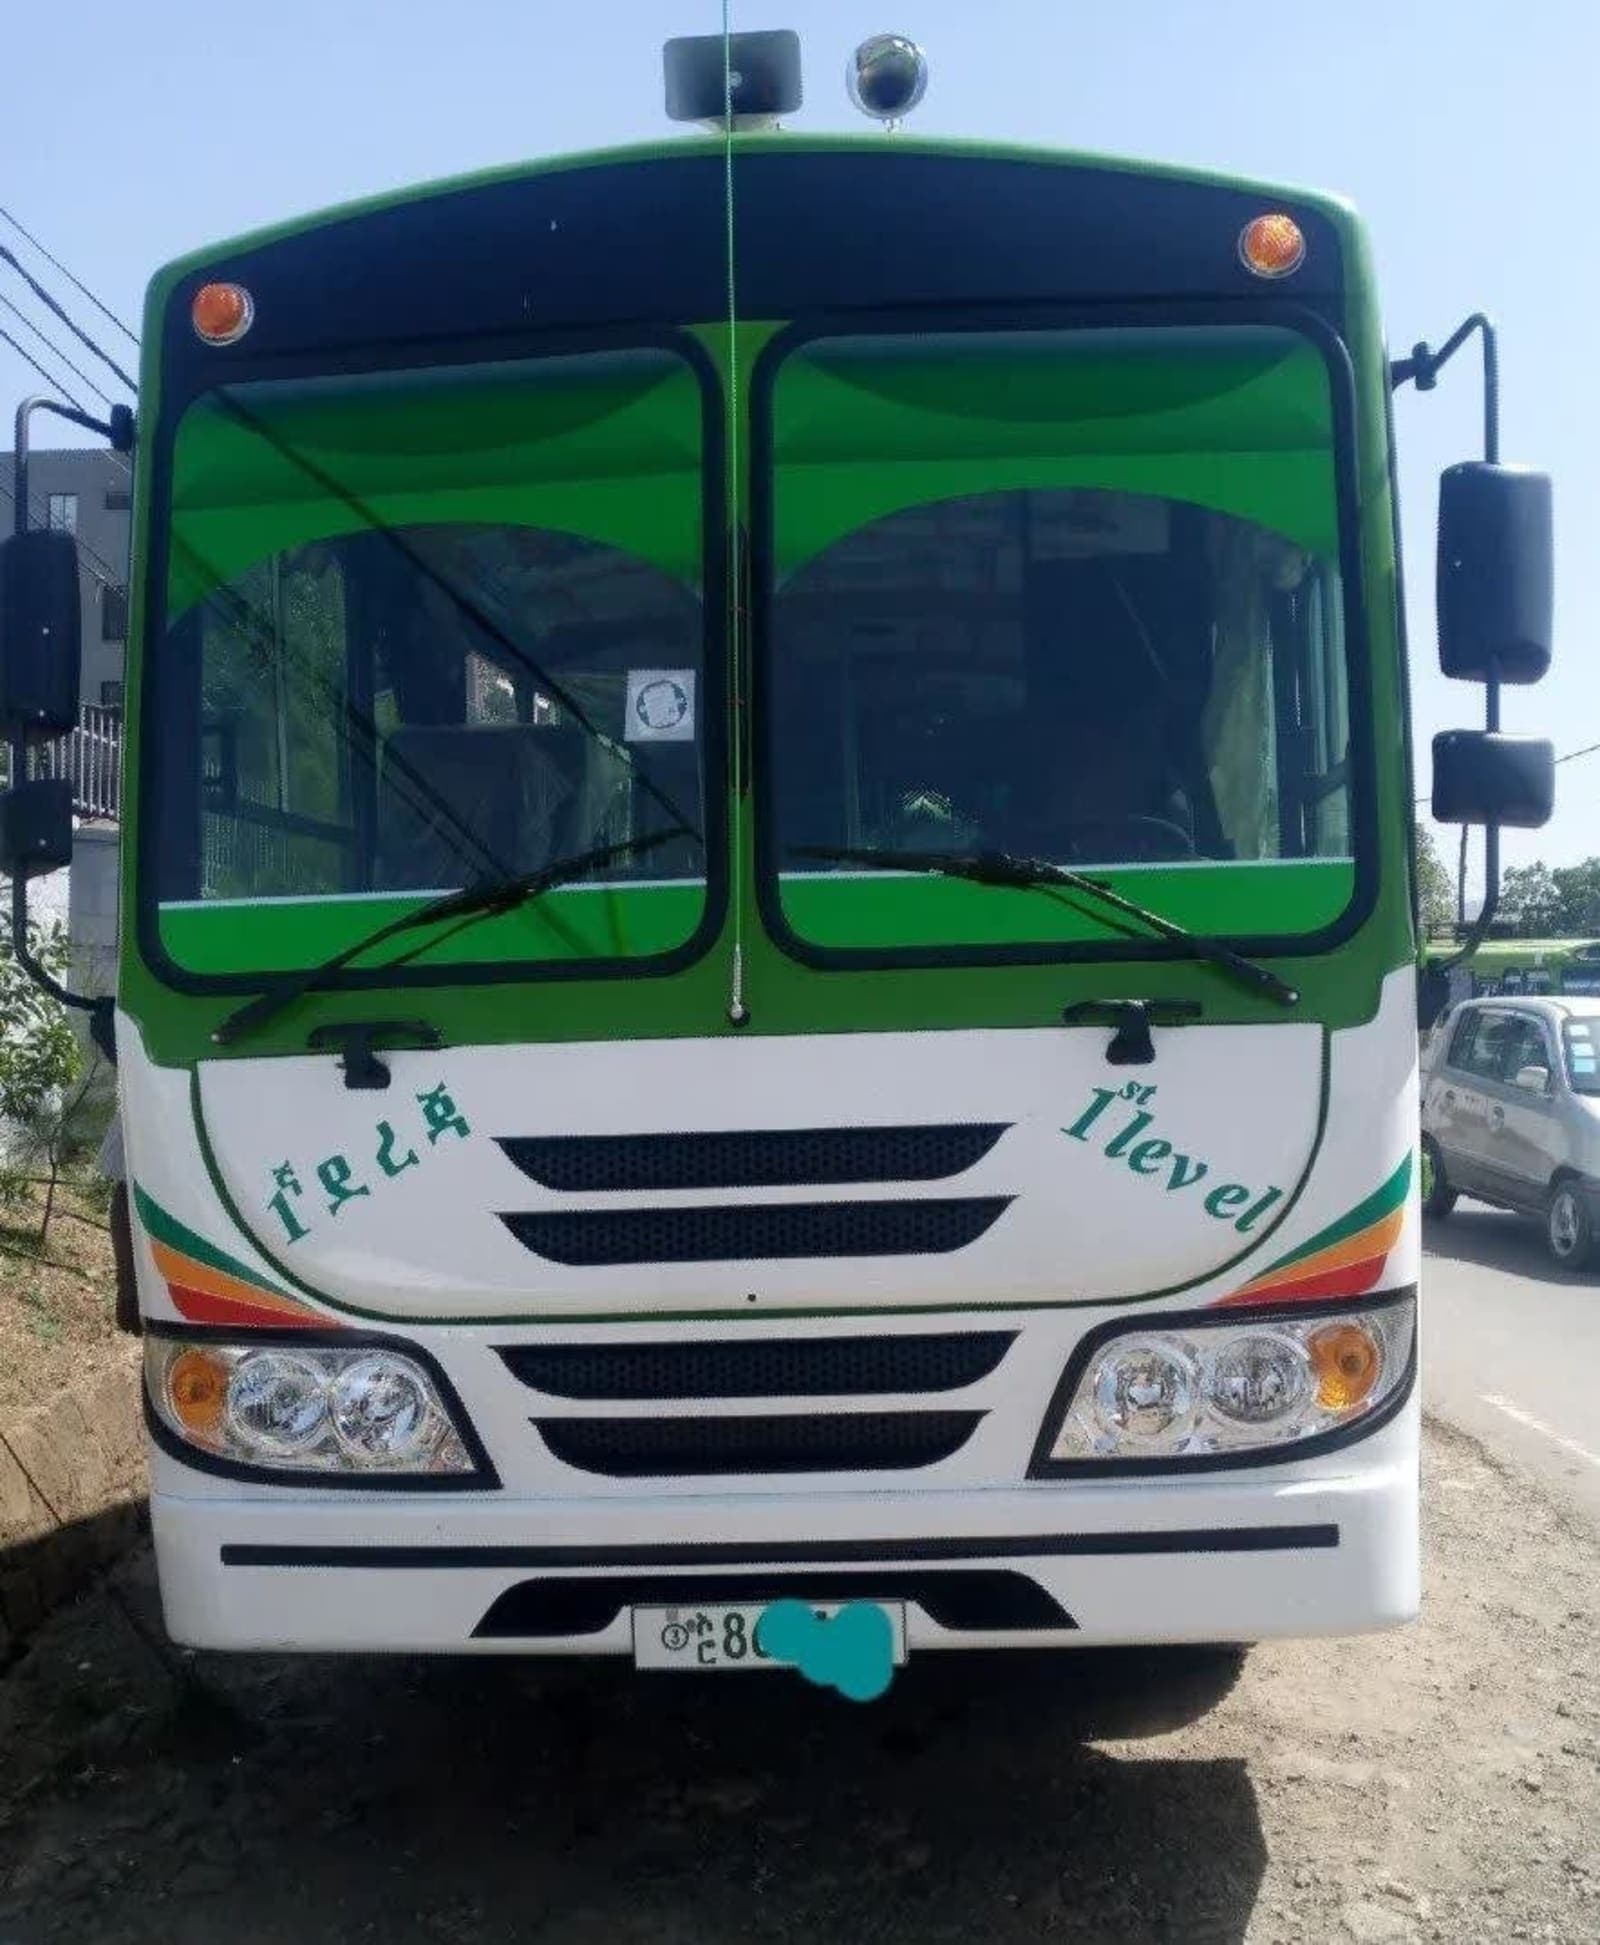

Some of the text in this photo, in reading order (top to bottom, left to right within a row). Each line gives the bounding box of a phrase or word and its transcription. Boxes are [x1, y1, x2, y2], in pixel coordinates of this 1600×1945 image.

[267, 1081, 471, 1245] 1ኛ ደረጃ
[1060, 1080, 1283, 1232] 1st level
